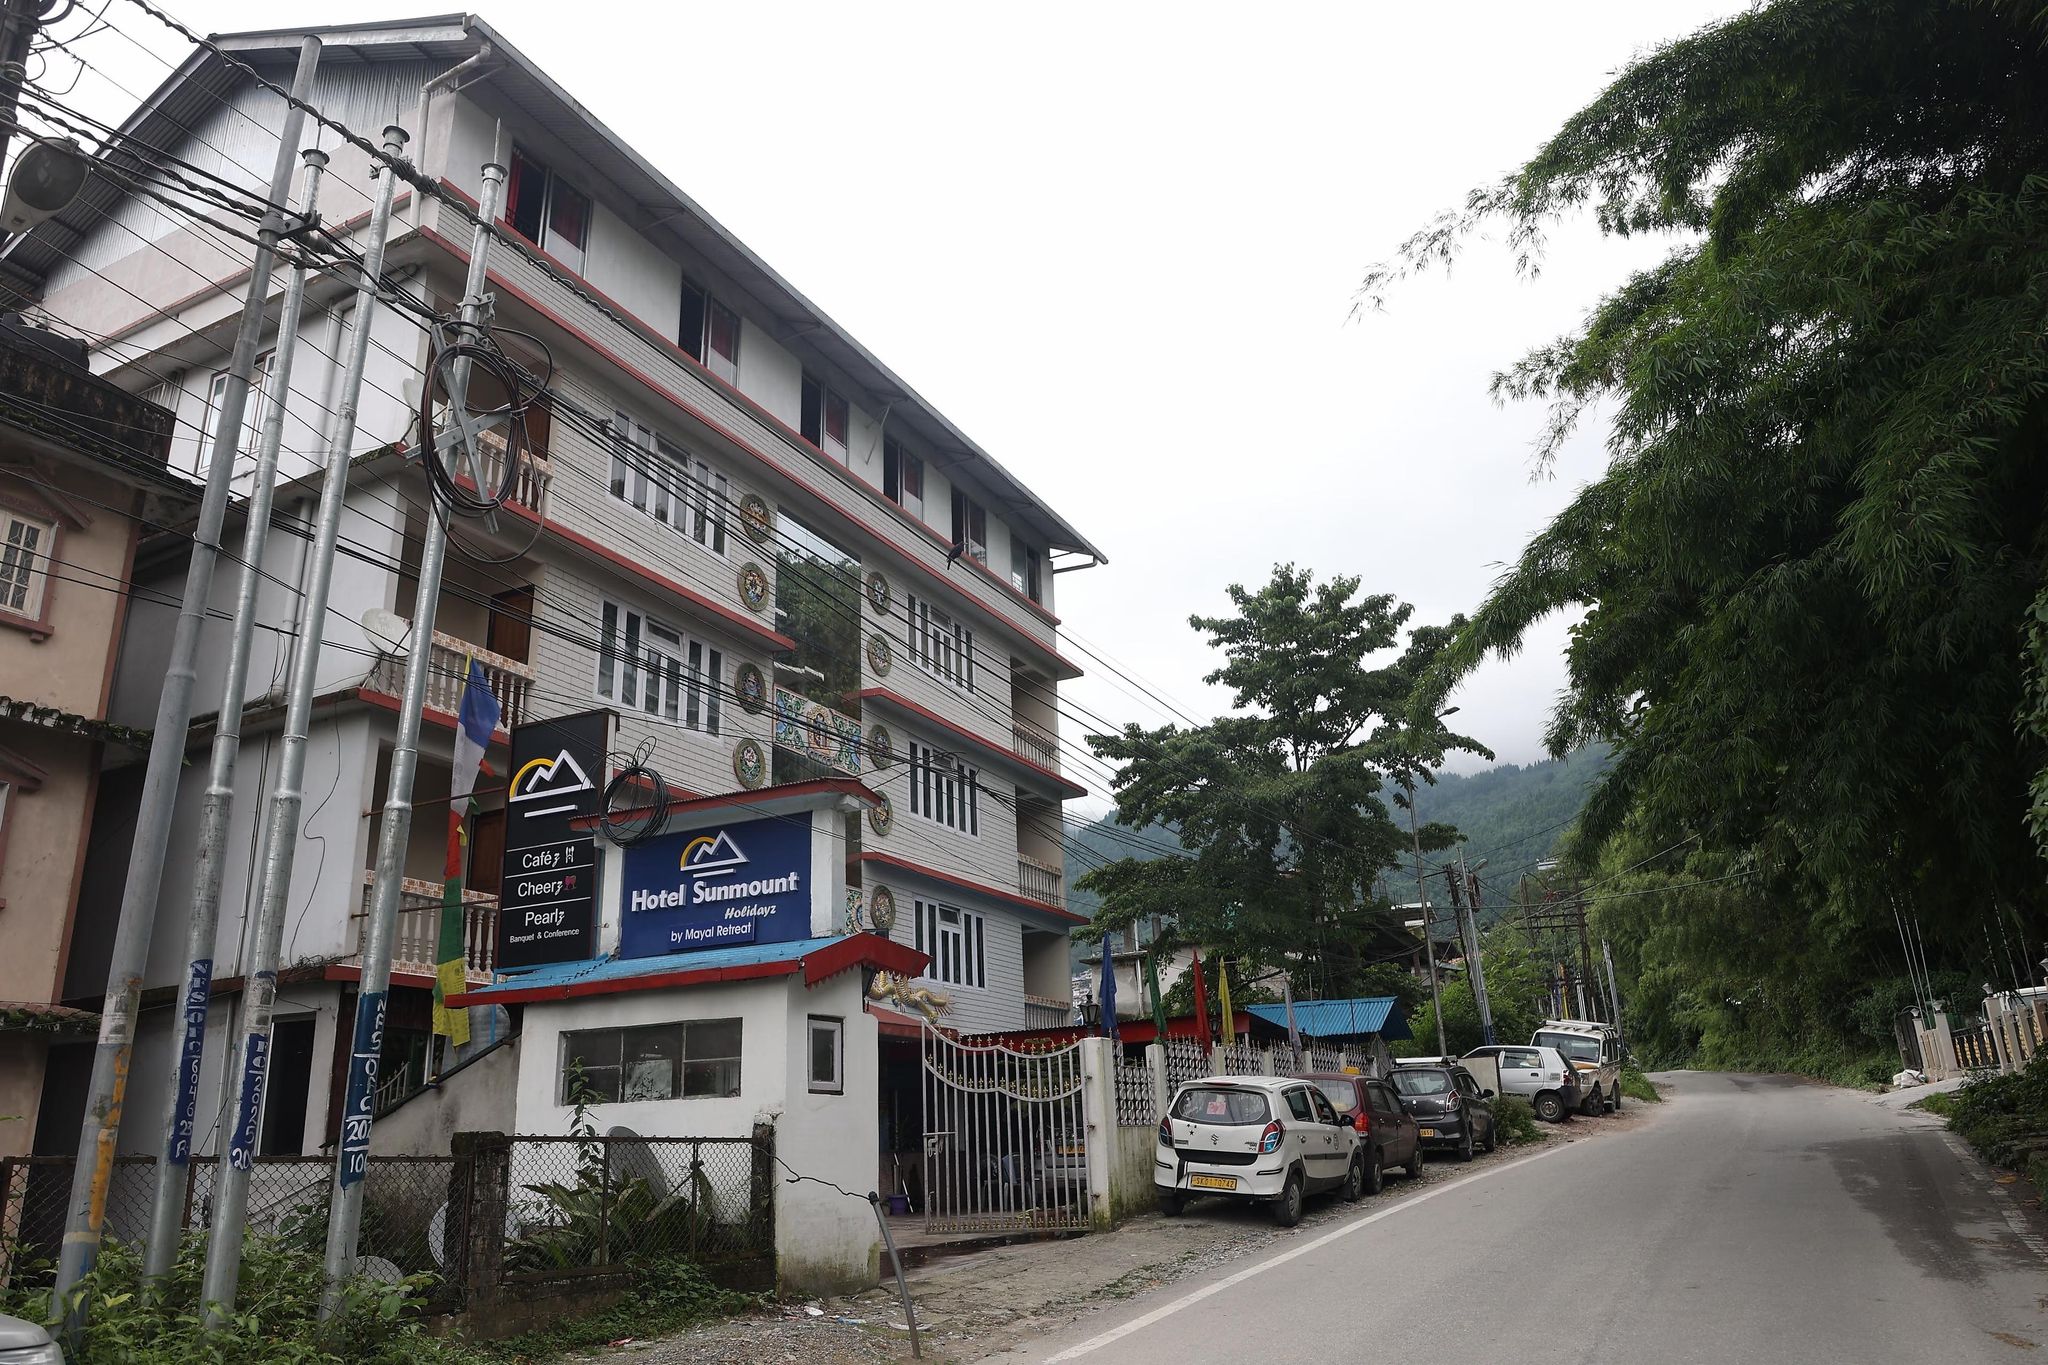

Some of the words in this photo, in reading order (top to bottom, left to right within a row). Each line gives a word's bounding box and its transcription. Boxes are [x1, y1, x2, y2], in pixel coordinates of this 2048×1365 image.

[522, 850, 560, 868] Caféz
[517, 880, 563, 897] Cheerz
[631, 884, 687, 912] Hotel
[692, 871, 800, 905] Sunmount
[525, 908, 565, 927] Pearlz
[724, 904, 777, 919] Holidayz
[509, 933, 535, 943] Banquet
[537, 931, 542, 940] &
[543, 928, 580, 939] Conference
[670, 931, 683, 943] by
[685, 927, 714, 941] Mayal
[716, 921, 752, 937] Retreat
